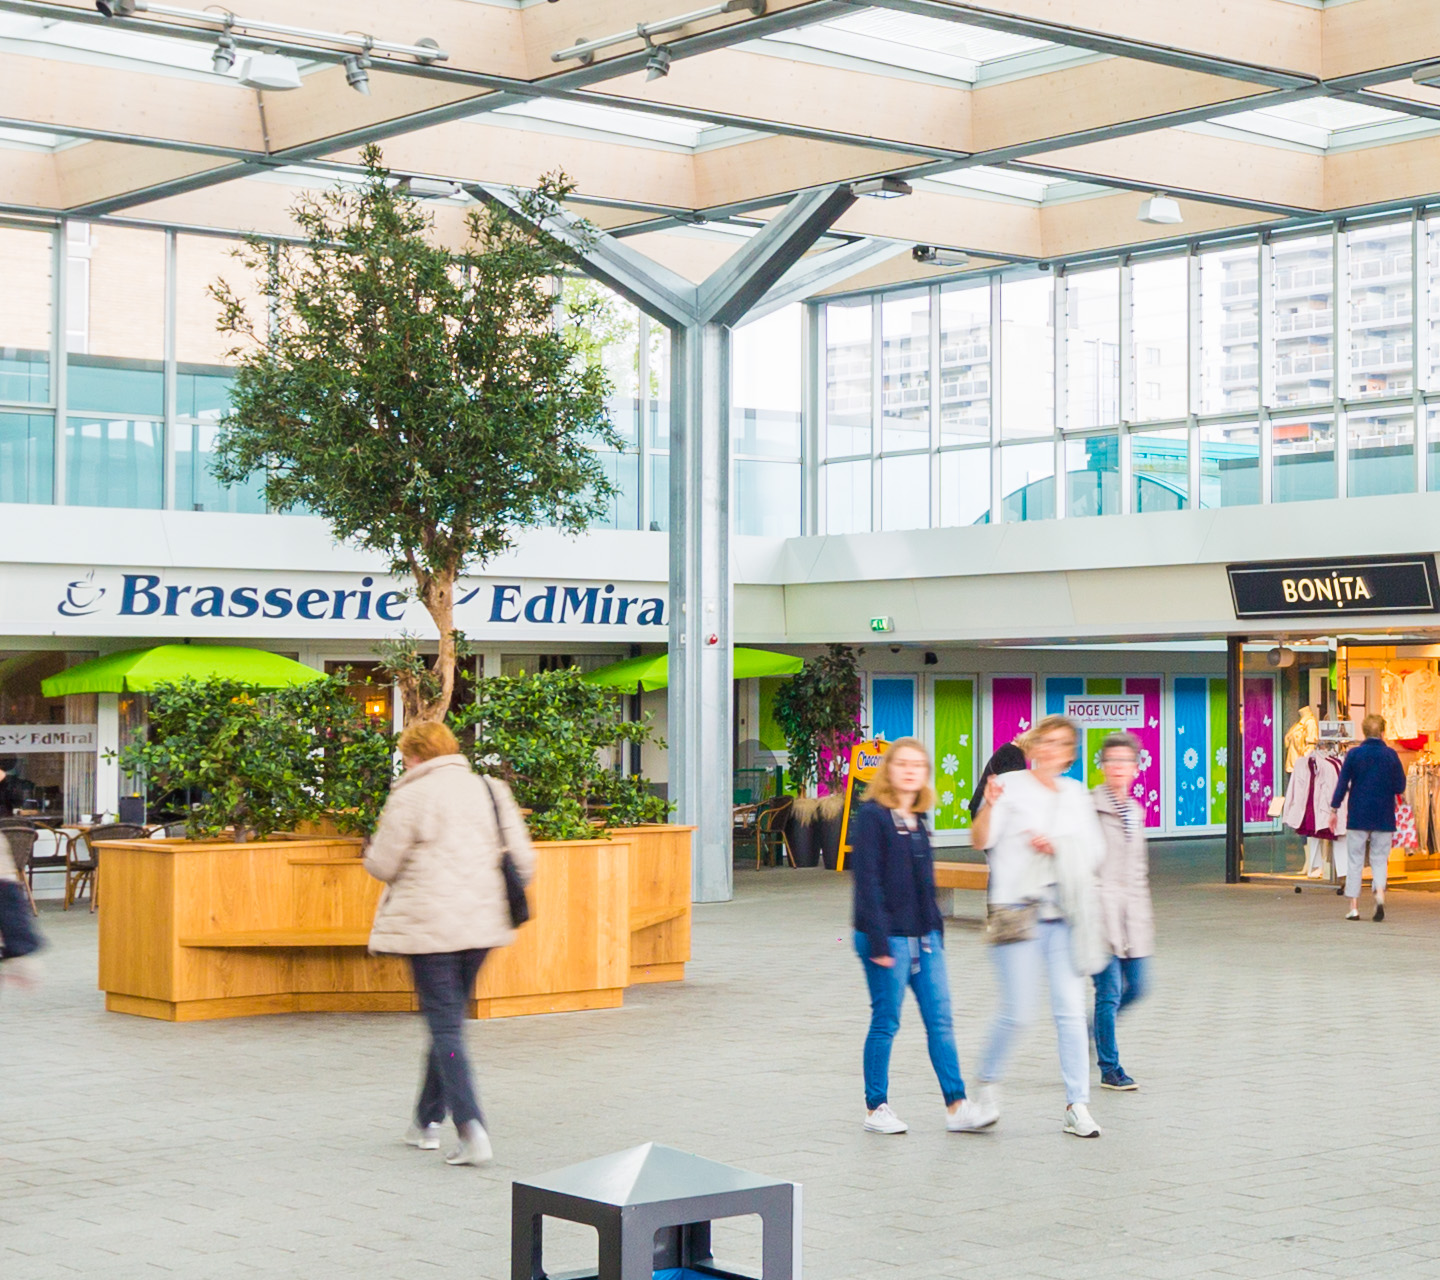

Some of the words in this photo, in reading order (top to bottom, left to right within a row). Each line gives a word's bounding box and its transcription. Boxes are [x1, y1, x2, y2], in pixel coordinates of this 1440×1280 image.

[117, 573, 407, 621] Brasserie
[488, 583, 671, 626] EdMira
[1068, 704, 1100, 716] HOGE
[1102, 704, 1140, 716] VUCHT
[30, 731, 93, 746] EdMiral
